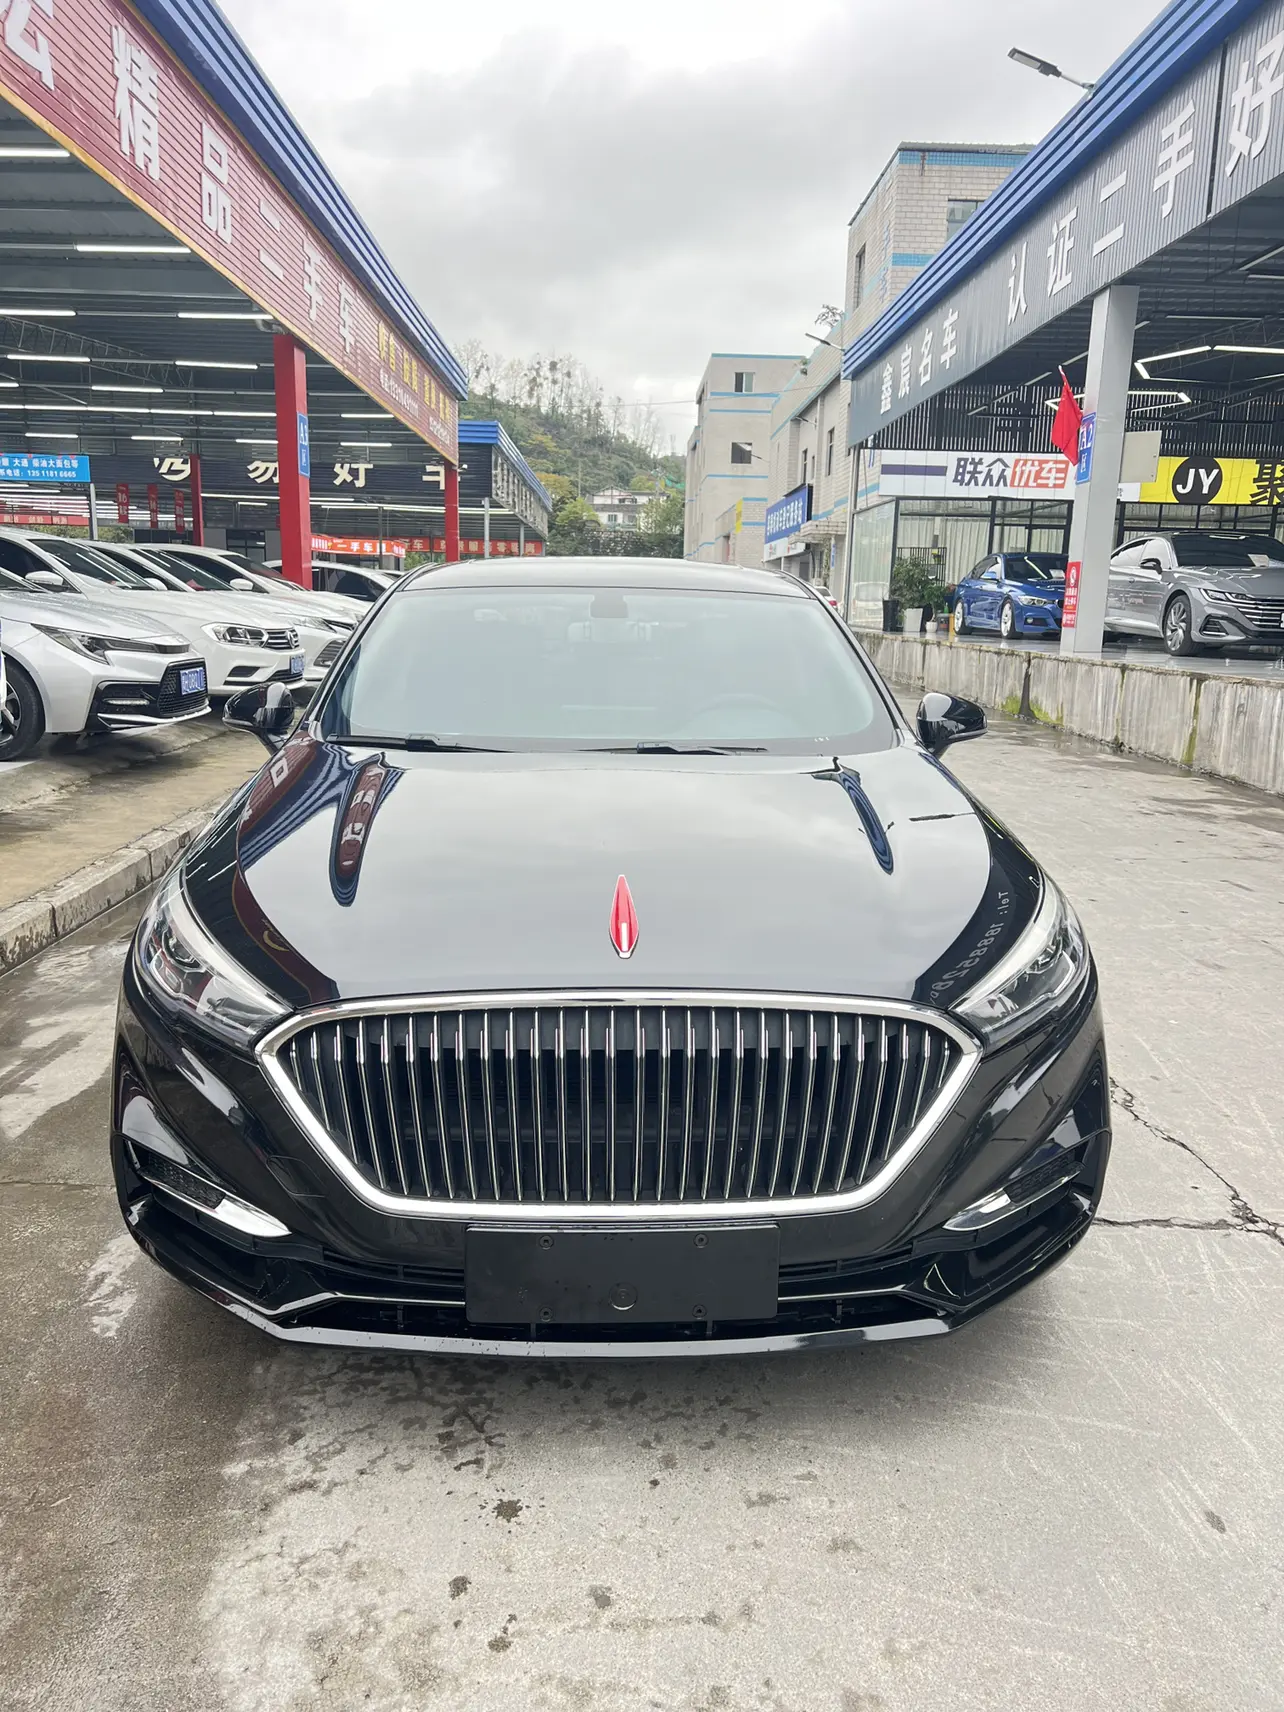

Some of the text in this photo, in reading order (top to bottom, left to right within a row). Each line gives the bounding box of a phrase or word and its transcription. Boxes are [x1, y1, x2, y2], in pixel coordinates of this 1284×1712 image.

[1080, 423, 1093, 450] A2
[953, 457, 1066, 488] 联众优车
[1176, 468, 1220, 494] JY
